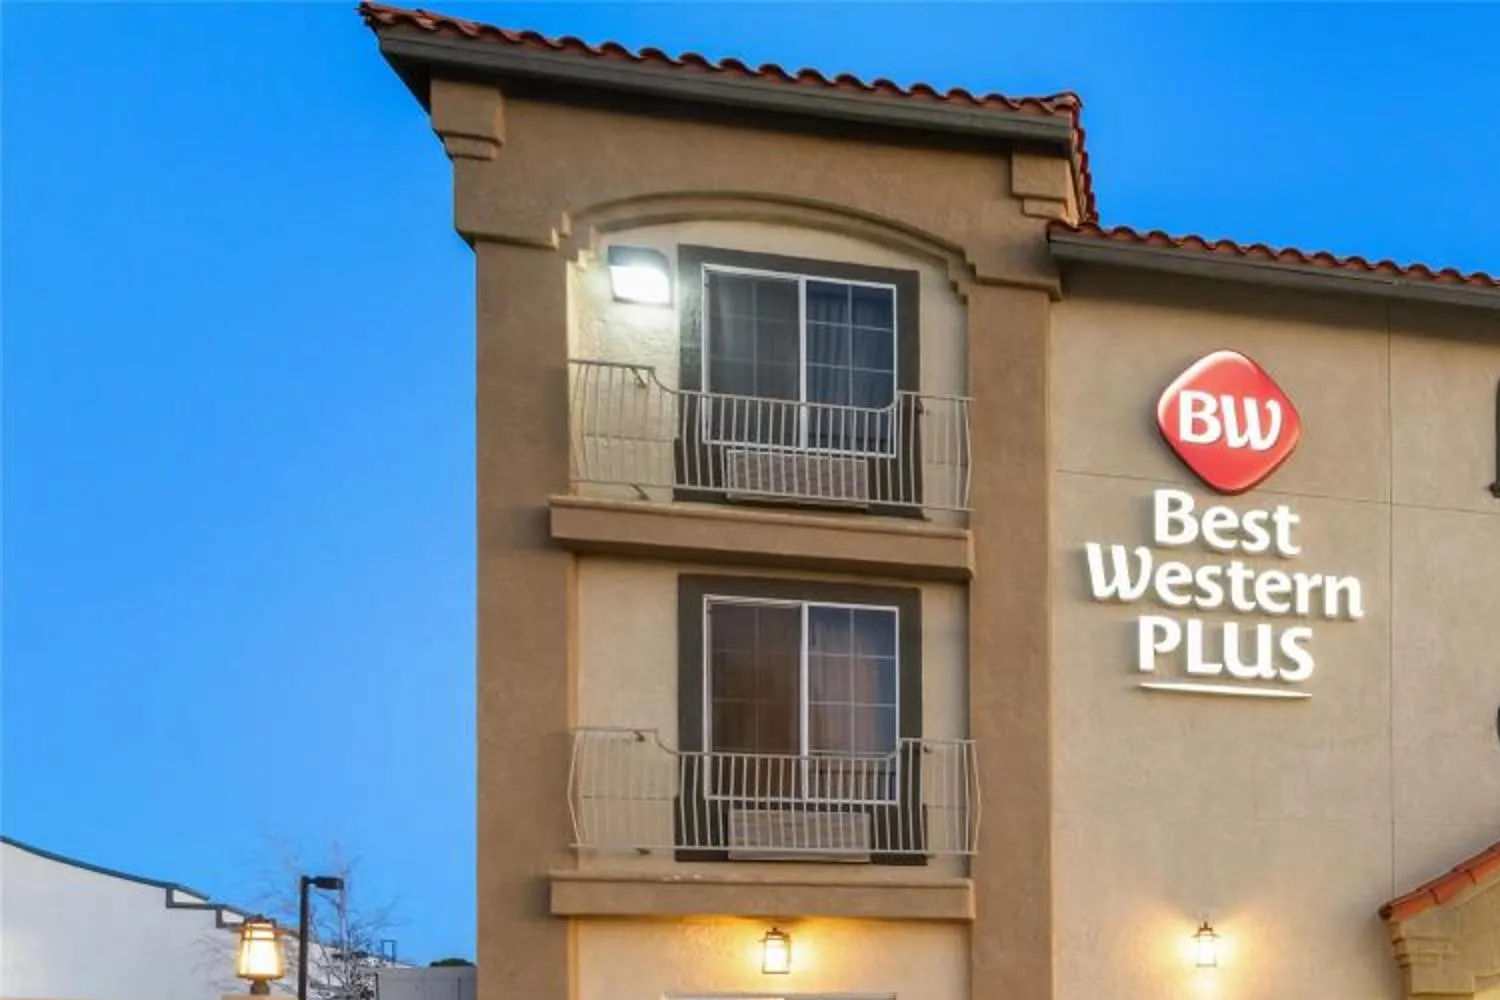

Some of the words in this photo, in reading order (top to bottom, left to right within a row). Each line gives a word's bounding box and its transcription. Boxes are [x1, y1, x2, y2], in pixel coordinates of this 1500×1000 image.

[1178, 390, 1283, 451] BW
[1153, 489, 1301, 557] Best
[1086, 542, 1365, 620] Western
[1137, 615, 1315, 682] PLUS
